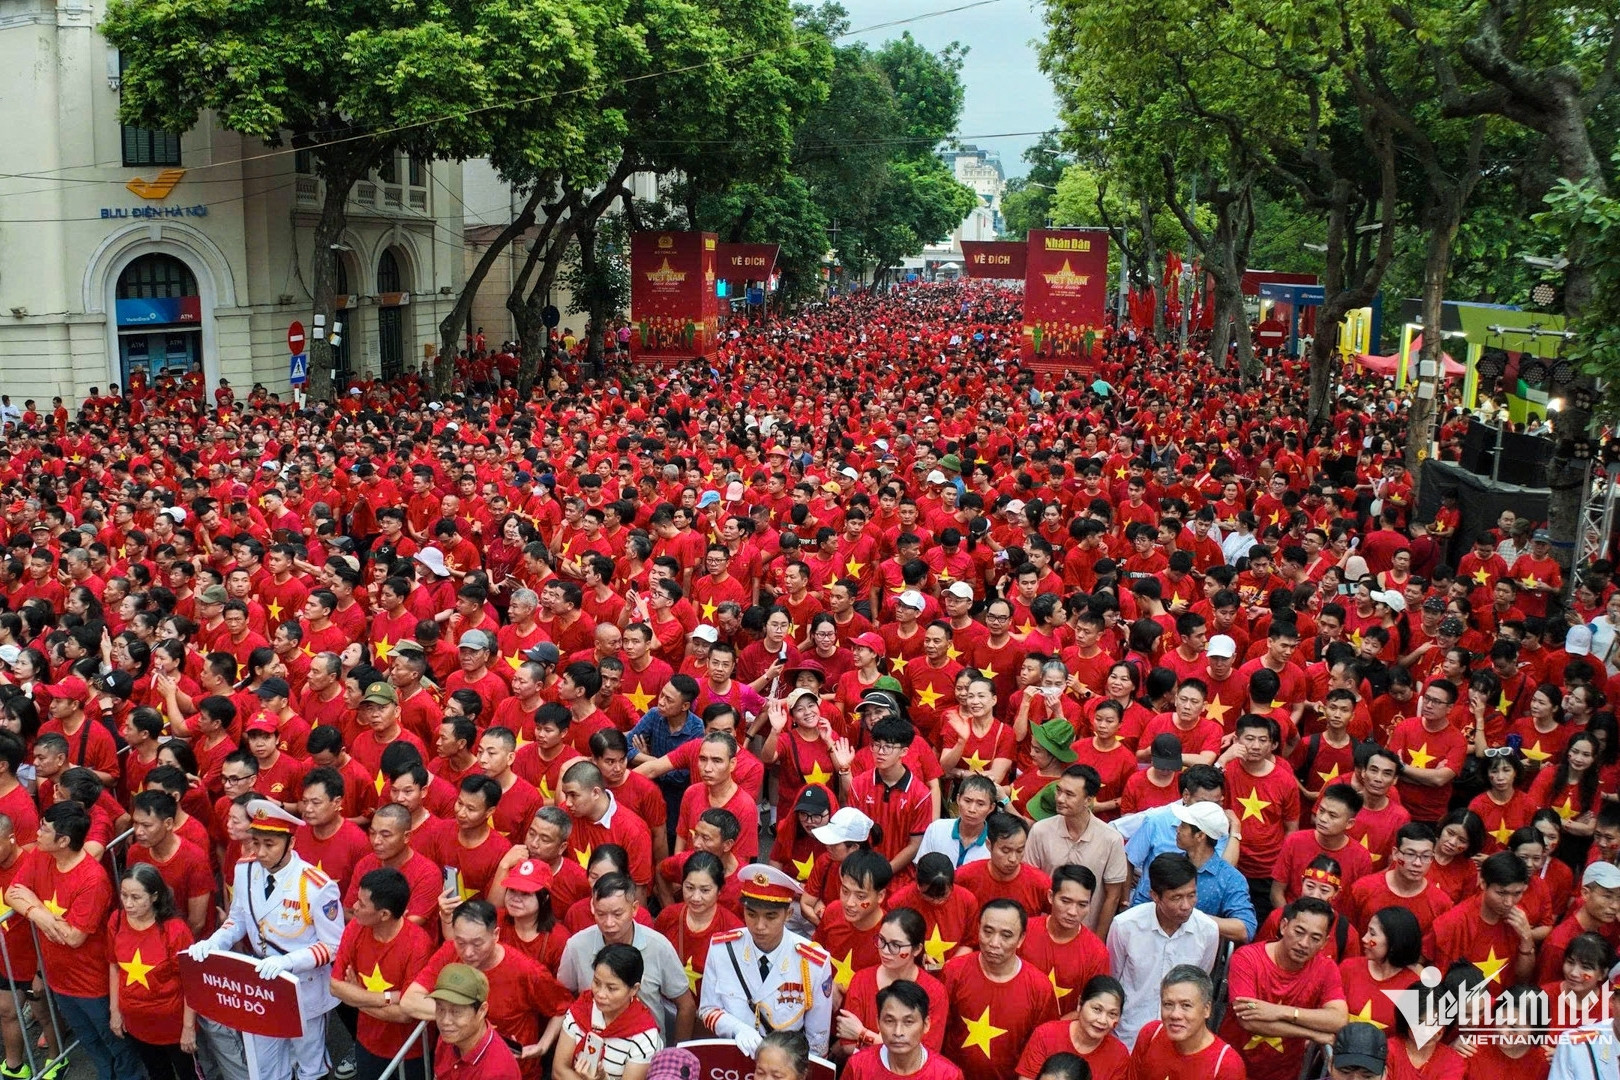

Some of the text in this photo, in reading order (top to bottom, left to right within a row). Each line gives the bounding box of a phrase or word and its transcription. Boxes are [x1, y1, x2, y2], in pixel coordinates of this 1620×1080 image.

[164, 204, 184, 218] HÀ
[1045, 237, 1091, 250] Nhân Dân
[731, 255, 743, 266] VỀ
[973, 252, 986, 264] VỀ
[202, 972, 275, 1002] NHÂN DÂN
[216, 992, 266, 1015] THỦ ĐÔ
